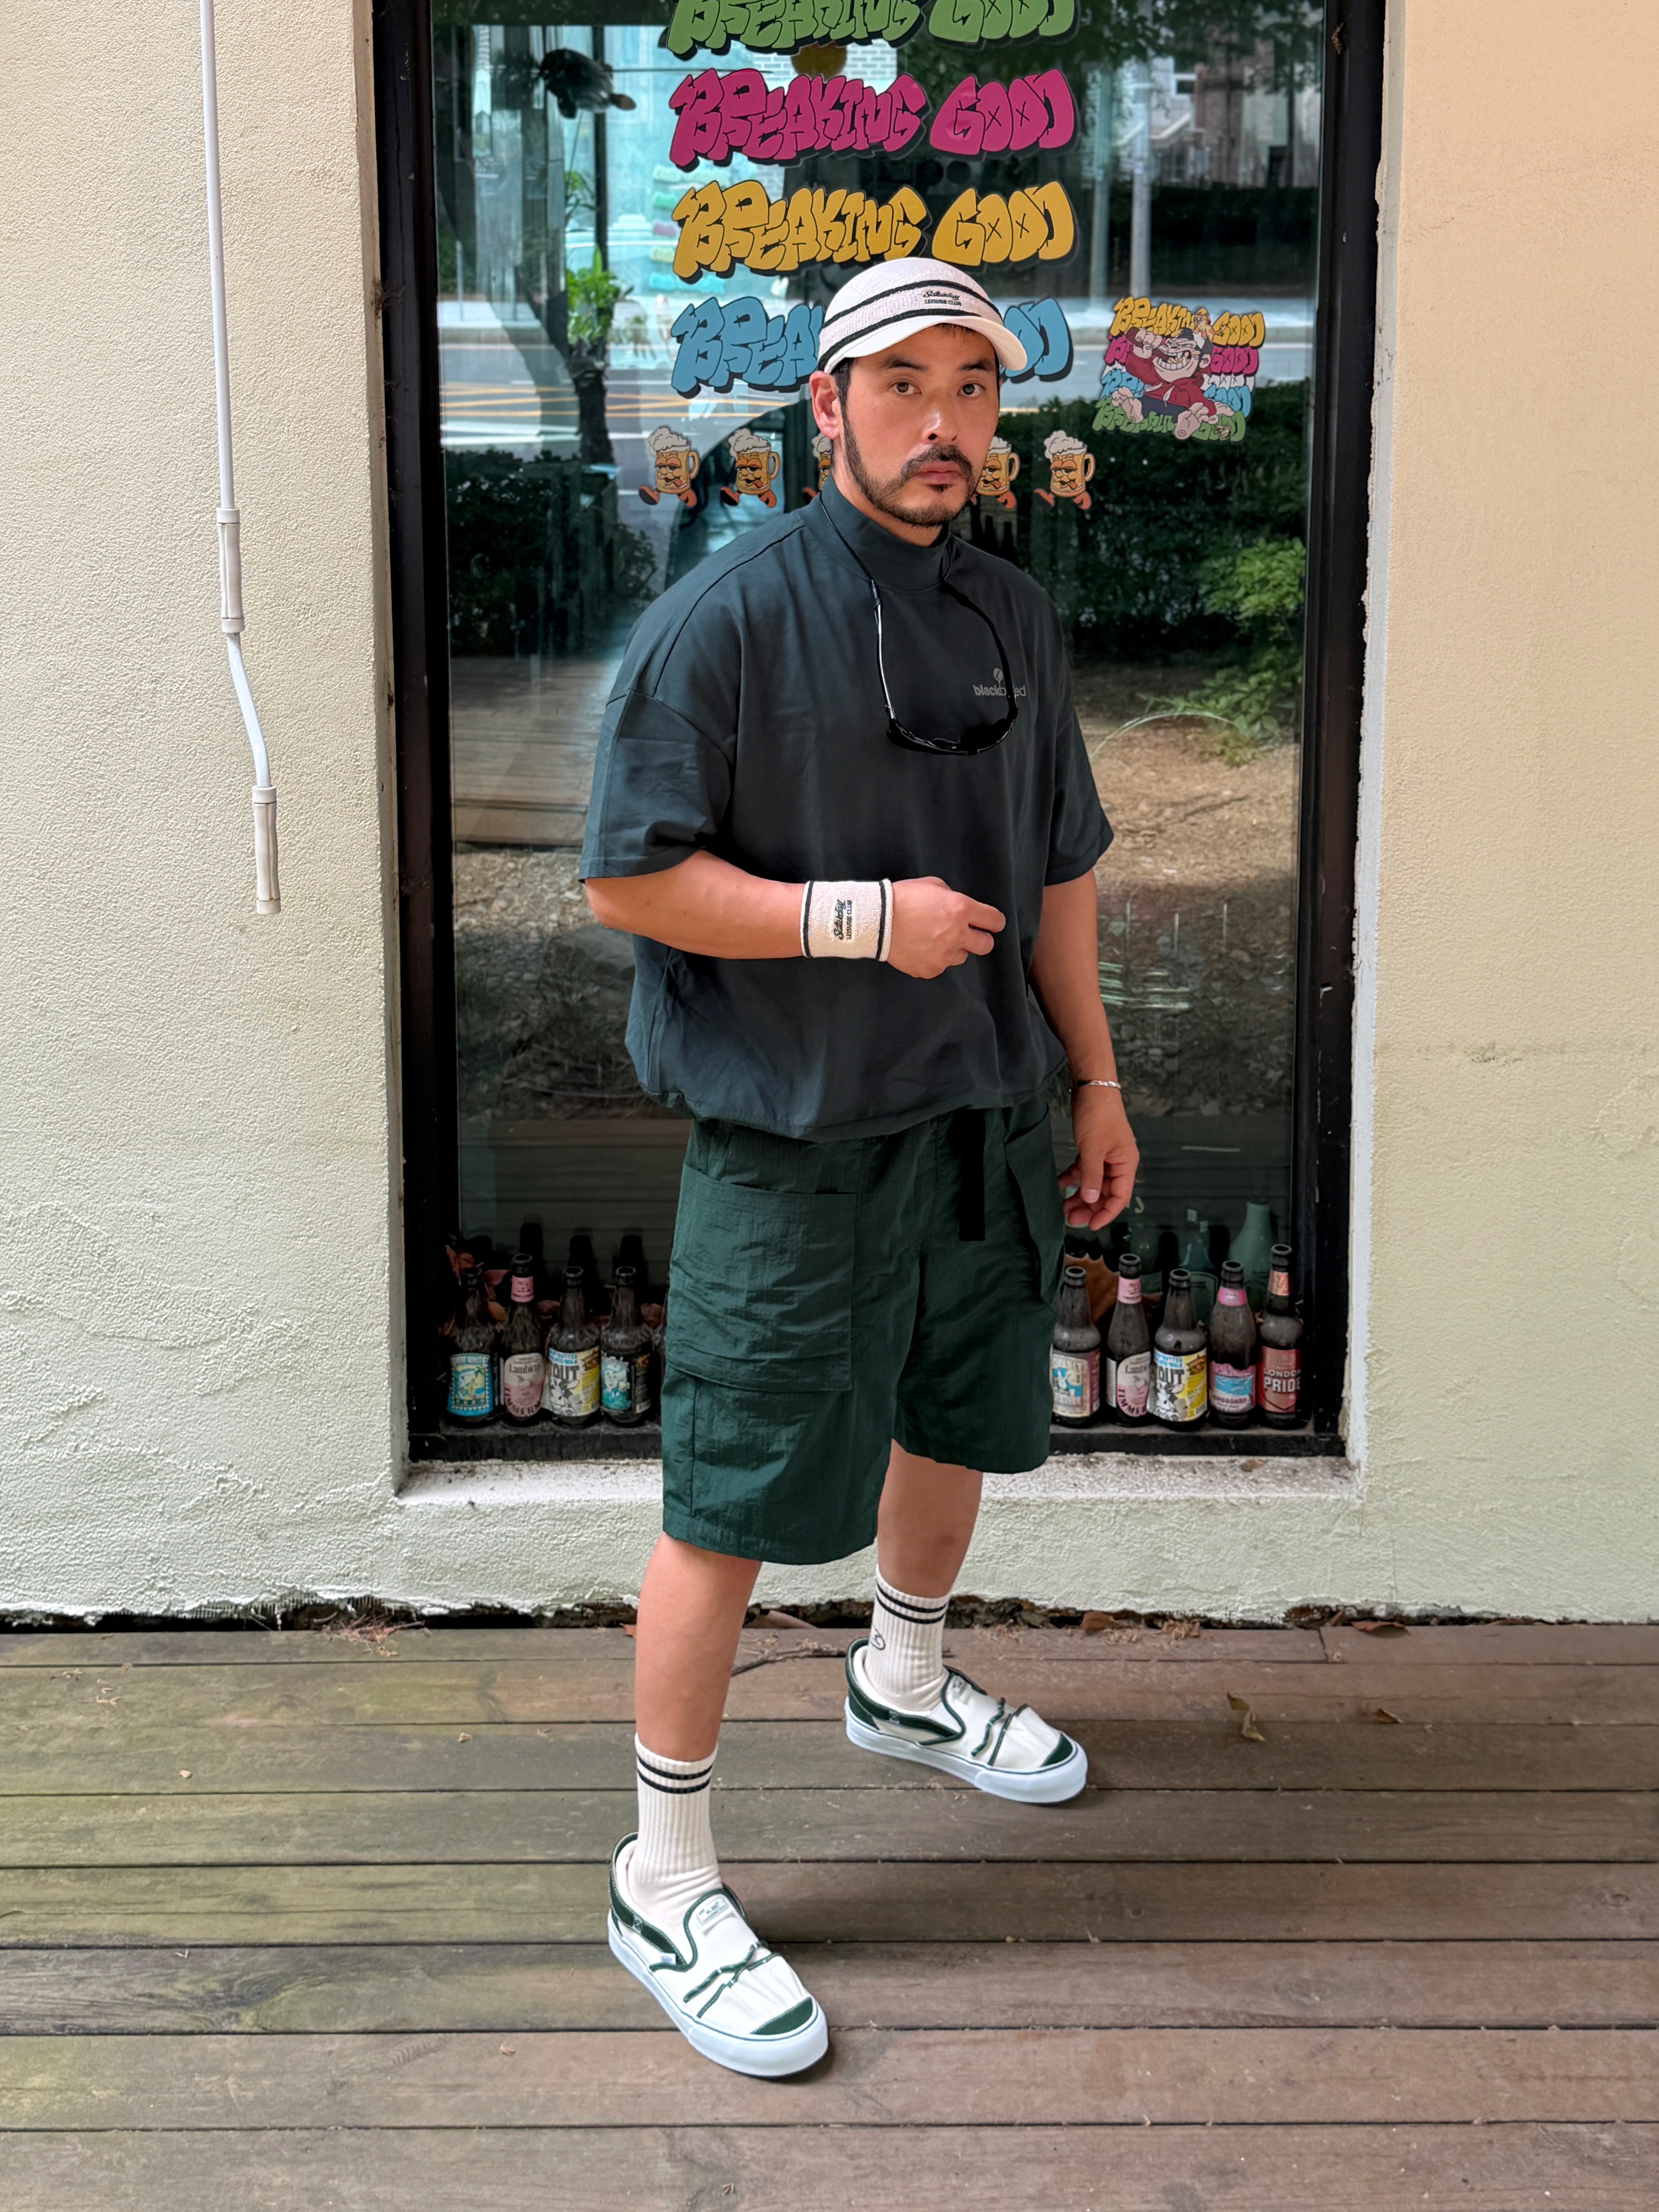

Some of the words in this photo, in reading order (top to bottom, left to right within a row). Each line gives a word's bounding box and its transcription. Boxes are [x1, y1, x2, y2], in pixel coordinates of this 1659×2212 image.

[669, 68, 927, 168] BREAKING
[930, 69, 1075, 155] GOOD
[671, 180, 927, 279] BREAKING
[932, 181, 1075, 266] GOOD
[923, 291, 960, 301] Saturday
[1110, 297, 1211, 337] BREAKIN
[671, 296, 824, 393] BREA
[1003, 298, 1070, 378] OD
[834, 899, 847, 940] Saturday
[1263, 1376, 1301, 1393] PRIDE
